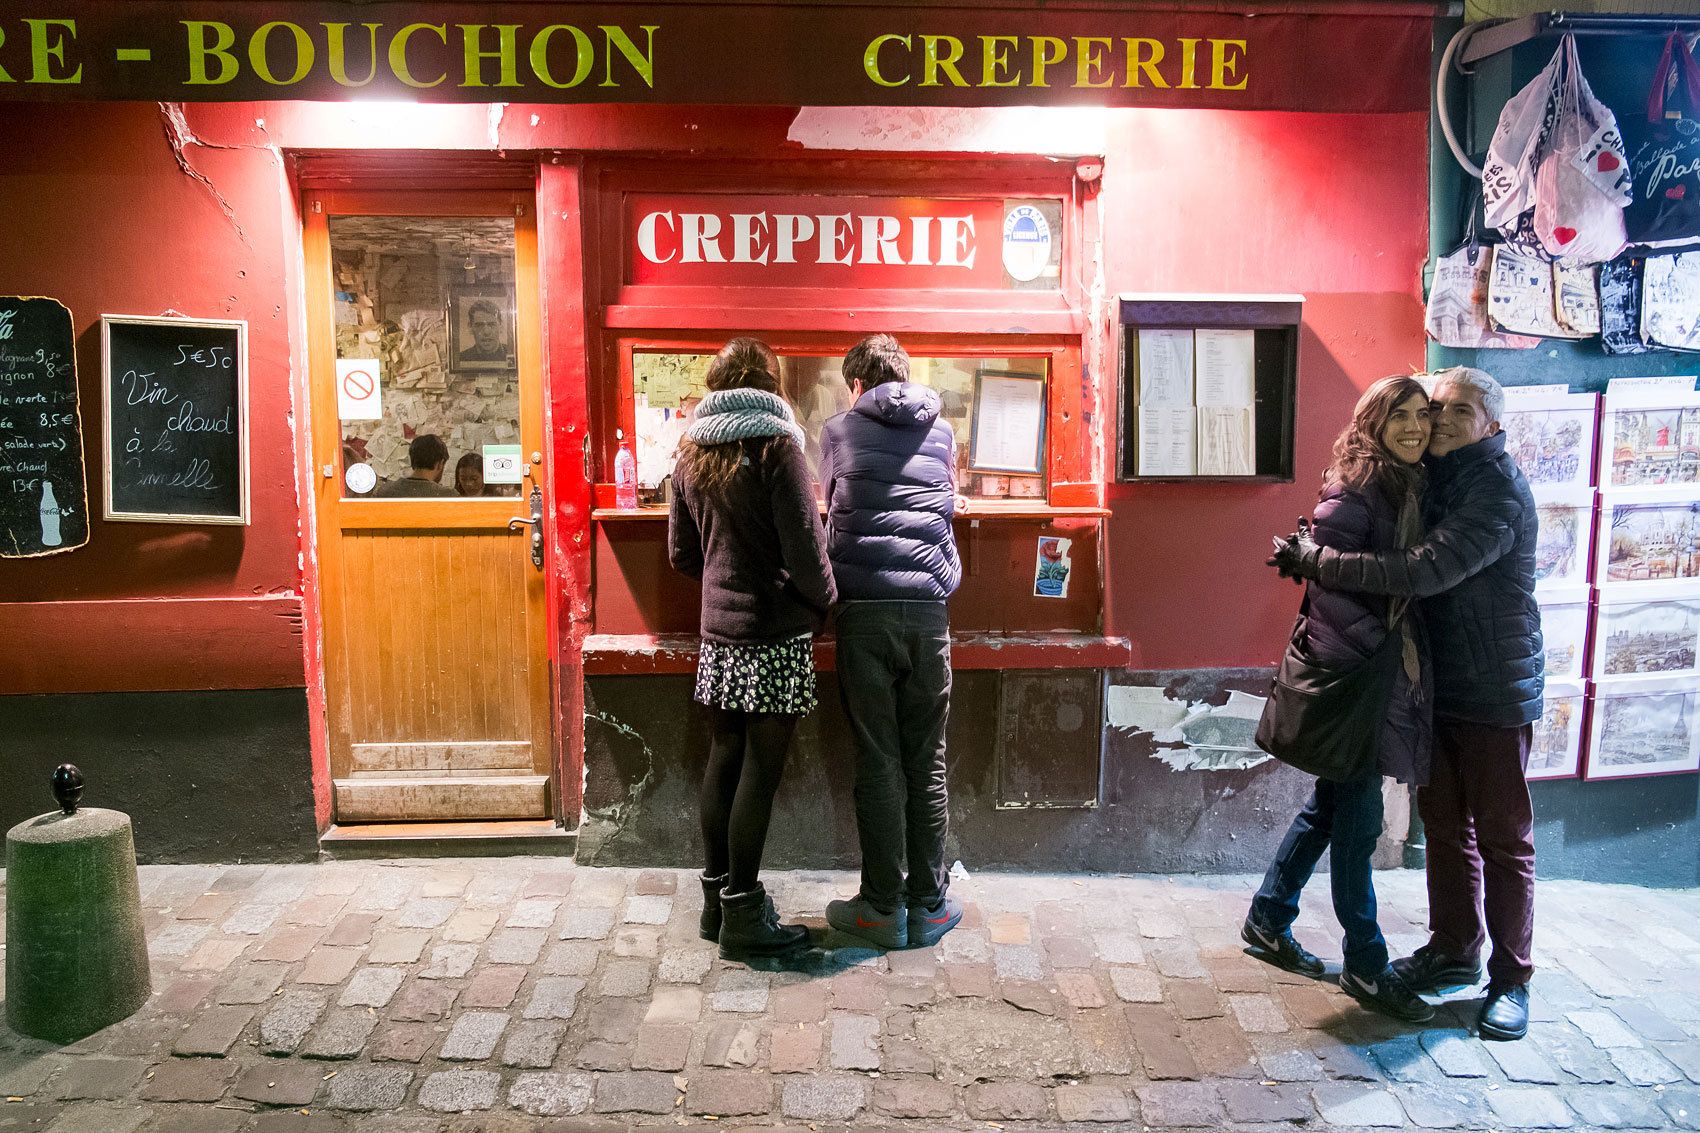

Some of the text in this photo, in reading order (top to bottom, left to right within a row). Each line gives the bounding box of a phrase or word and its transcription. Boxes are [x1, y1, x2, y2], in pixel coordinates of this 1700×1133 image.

[179, 20, 661, 89] BOUCHON
[863, 33, 1250, 91] CREPERIE
[636, 209, 977, 270] CREPERIE
[173, 344, 234, 370] 5€50
[121, 370, 179, 406] Vin
[167, 400, 234, 435] chaud
[4, 438, 35, 449] salade
